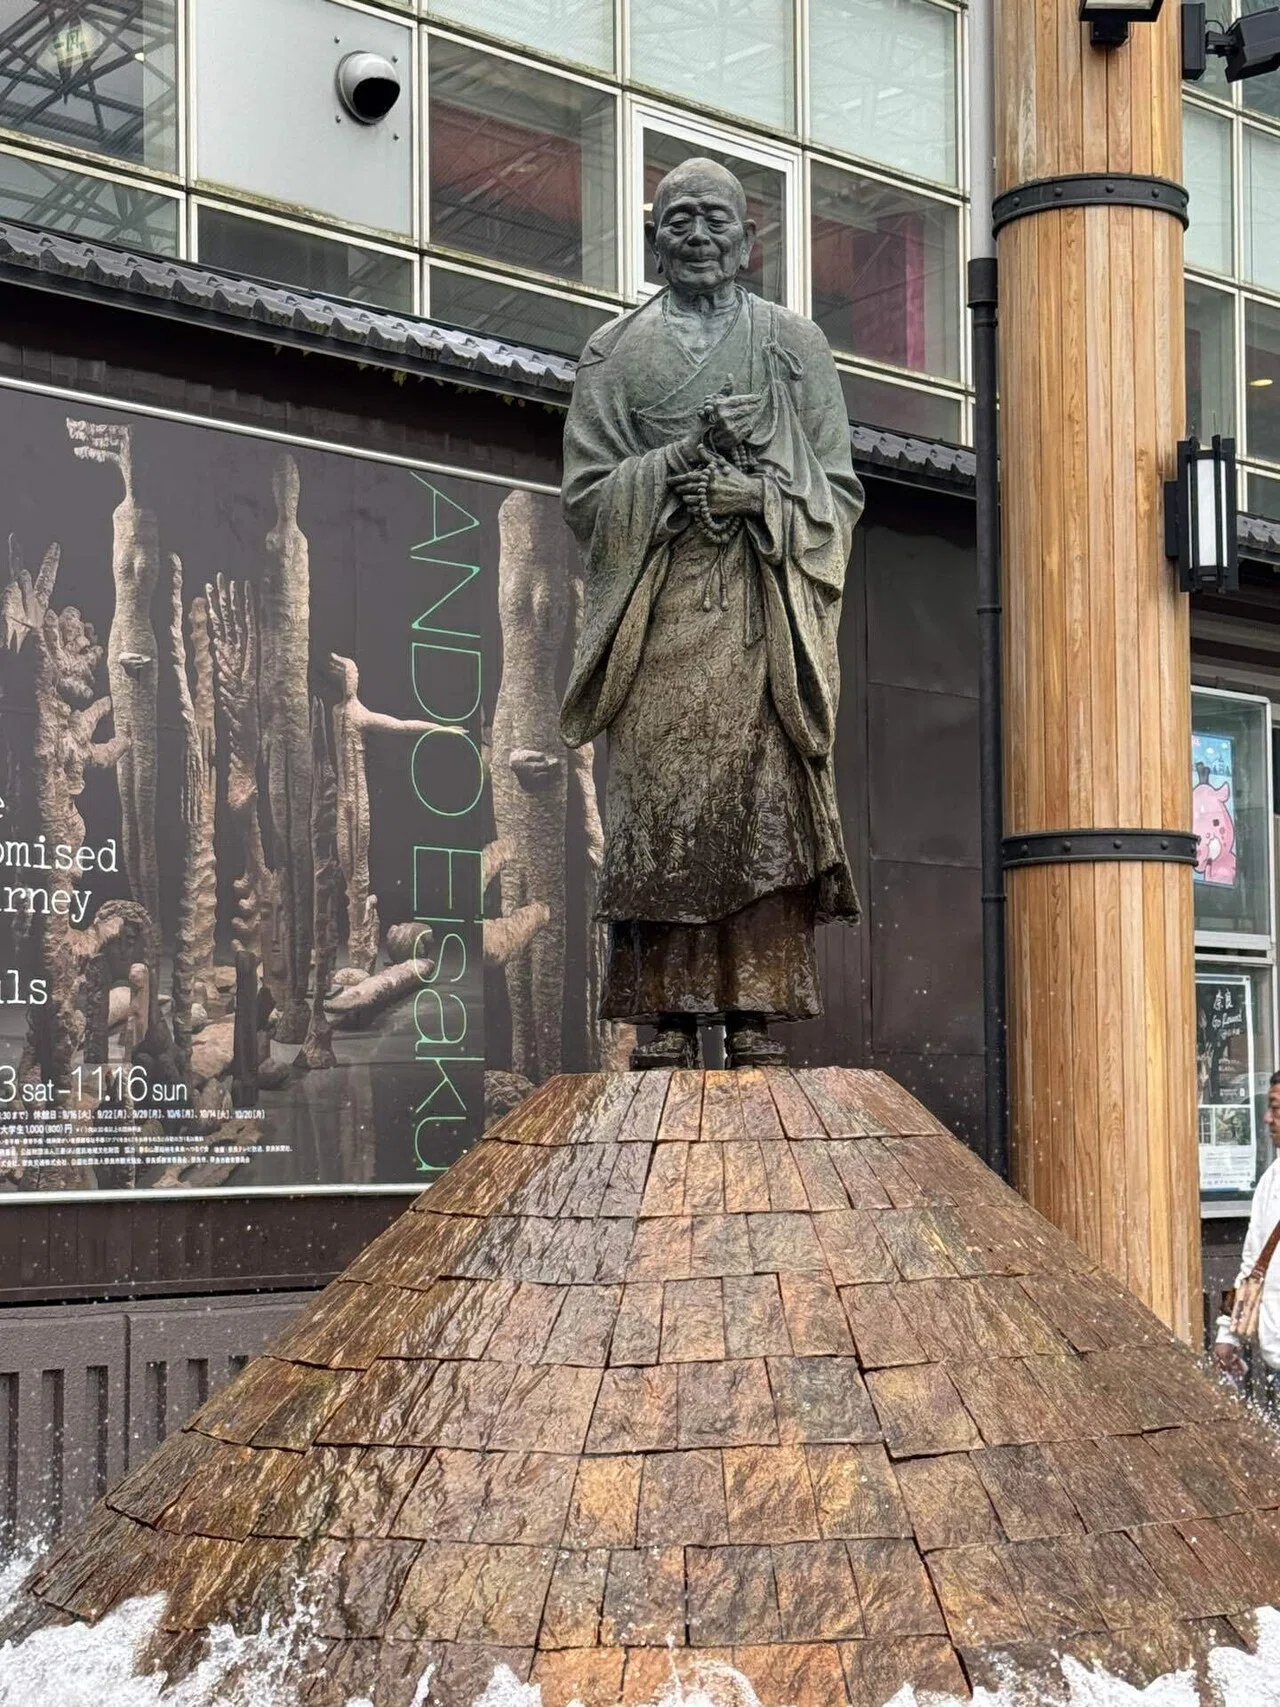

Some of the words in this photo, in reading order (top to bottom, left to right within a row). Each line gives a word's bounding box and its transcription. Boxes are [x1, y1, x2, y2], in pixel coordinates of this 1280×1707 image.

[410, 471, 484, 816] ANDO
[0, 835, 118, 872] mised
[0, 886, 92, 923] rney
[0, 970, 48, 1005] ls
[1213, 988, 1233, 1011] 奈良
[413, 846, 485, 1171] Eisaku
[152, 1082, 188, 1102] sun
